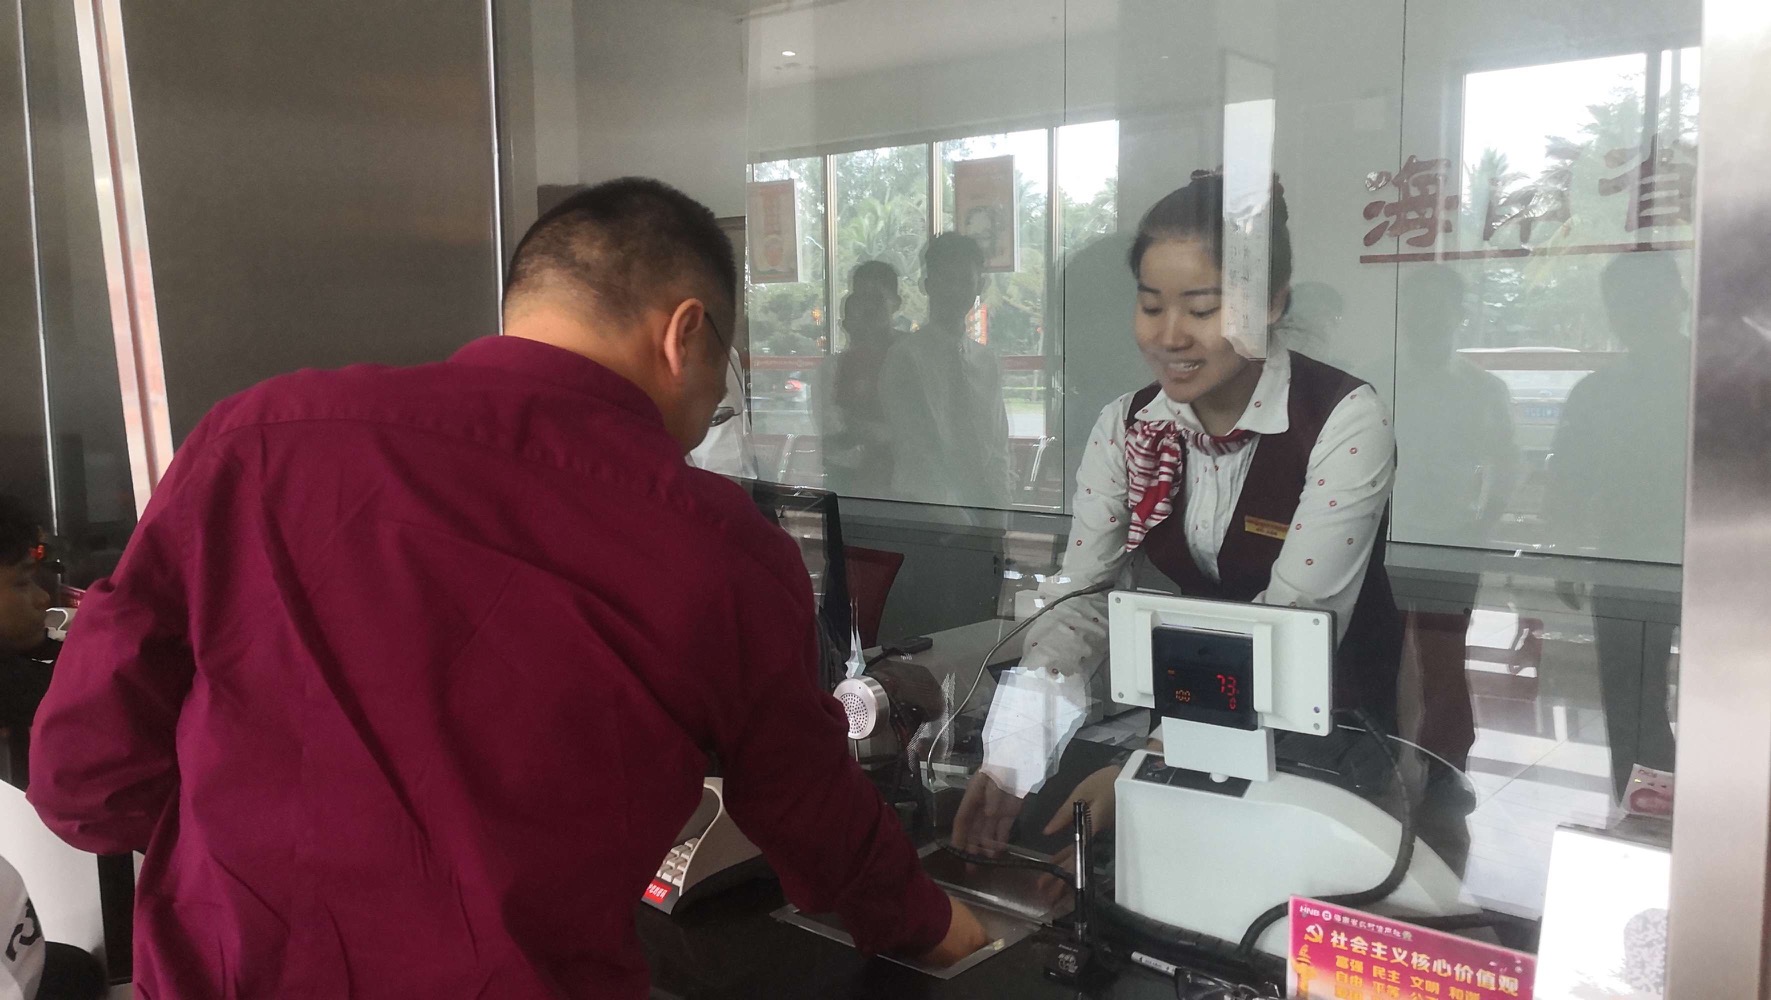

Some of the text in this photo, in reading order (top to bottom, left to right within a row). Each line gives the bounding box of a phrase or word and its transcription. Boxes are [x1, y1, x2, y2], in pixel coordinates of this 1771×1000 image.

[1299, 905, 1320, 917] HNB
[1330, 930, 1519, 997] 社会主义核心价值观
[1335, 954, 1364, 974] 富强
[1372, 965, 1401, 984] 民主
[1410, 976, 1440, 995] 文明
[1335, 970, 1363, 988] 自由
[1372, 980, 1400, 998] 平等
